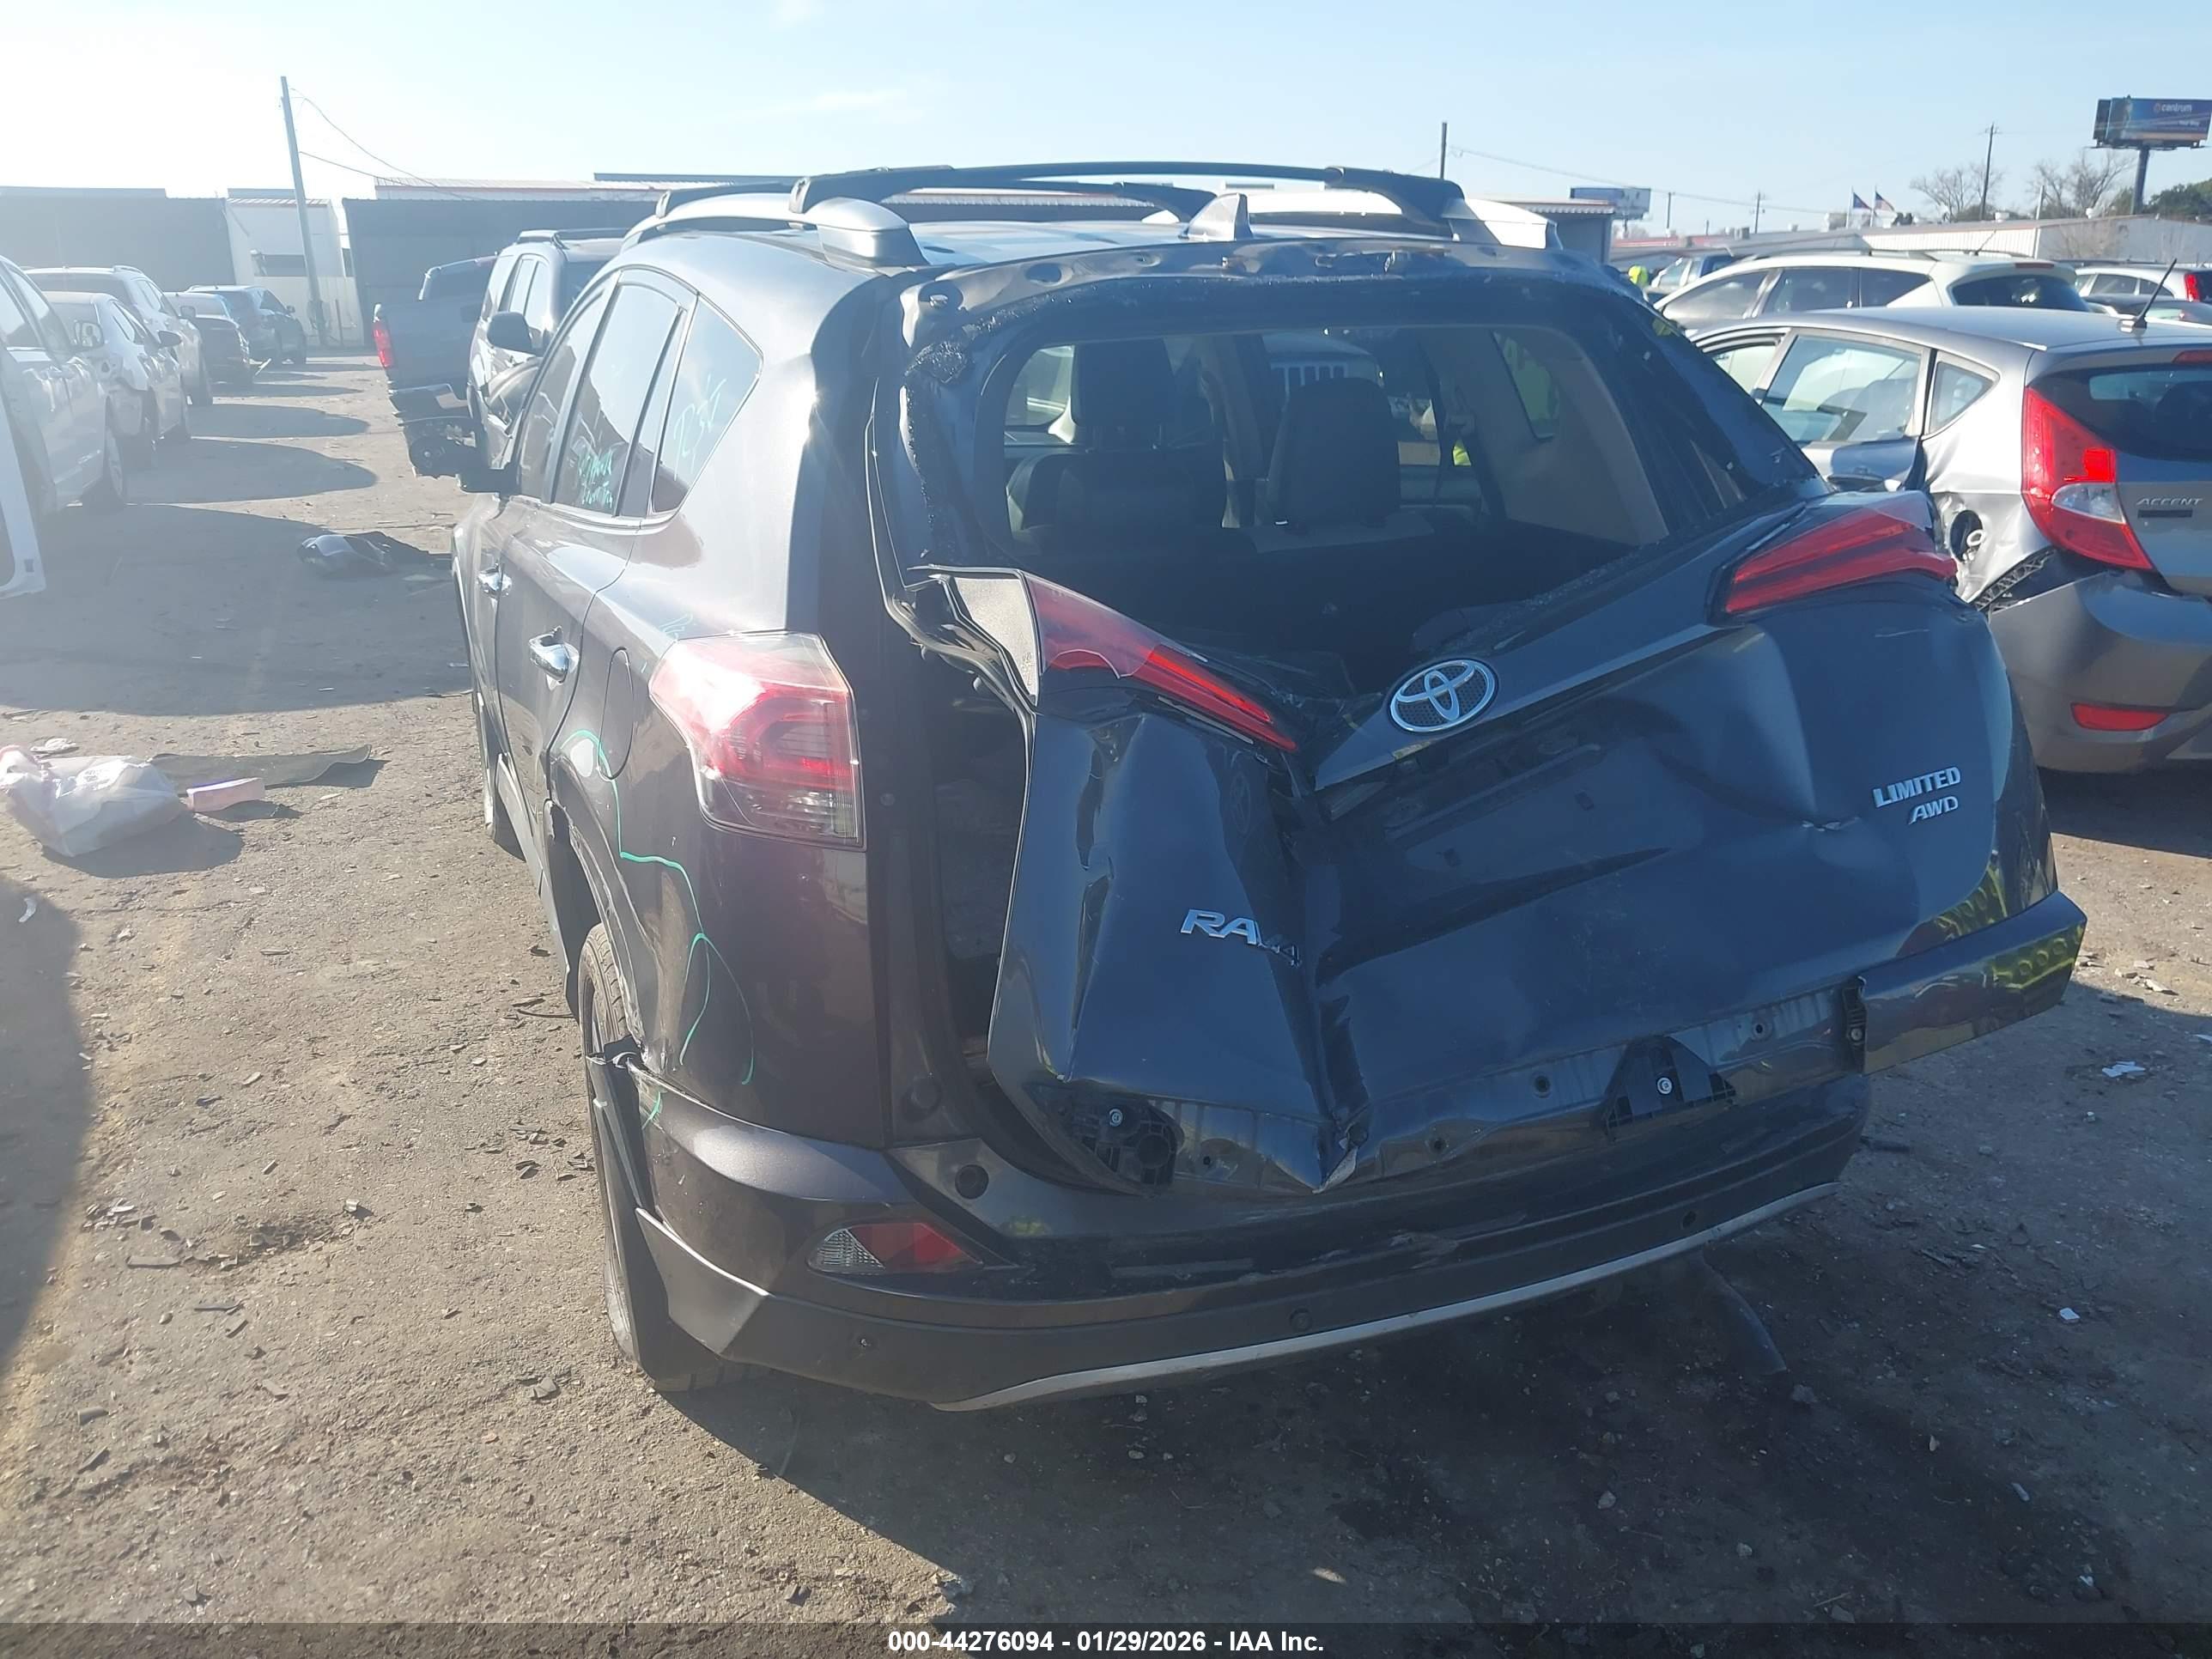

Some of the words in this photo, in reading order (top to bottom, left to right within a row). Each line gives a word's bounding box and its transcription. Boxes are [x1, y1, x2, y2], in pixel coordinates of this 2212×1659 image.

[1873, 766, 1961, 808] LIMITED
[1908, 795, 1959, 825] AWD
[1180, 908, 1301, 968] RA4
